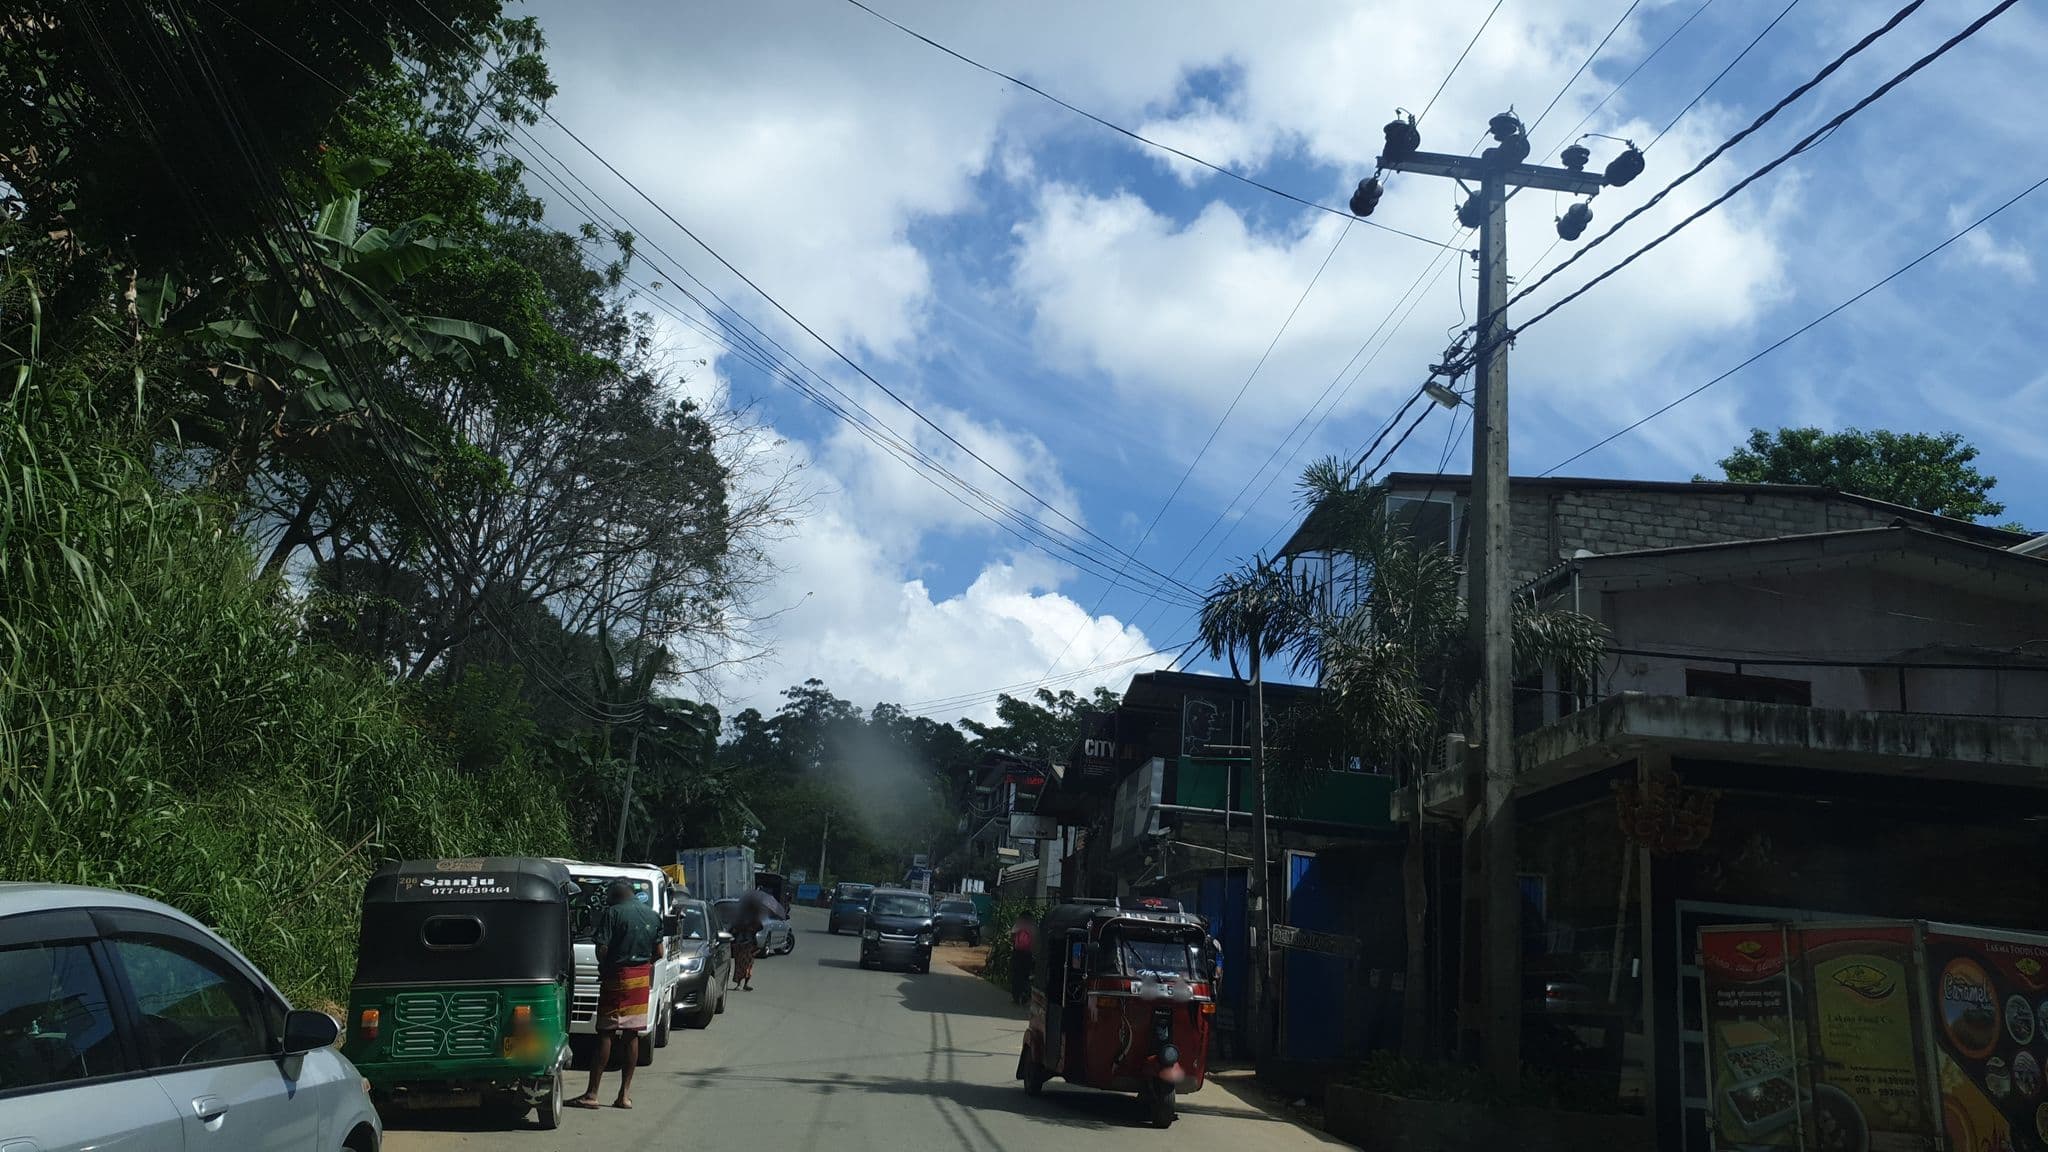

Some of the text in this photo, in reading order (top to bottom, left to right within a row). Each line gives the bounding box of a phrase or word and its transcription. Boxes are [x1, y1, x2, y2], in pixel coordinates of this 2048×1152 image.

[1085, 738, 1116, 760] CITY
[419, 876, 495, 888] Sanju
[432, 886, 510, 895] 077-6639464
[1943, 971, 1989, 1002] Caramel
